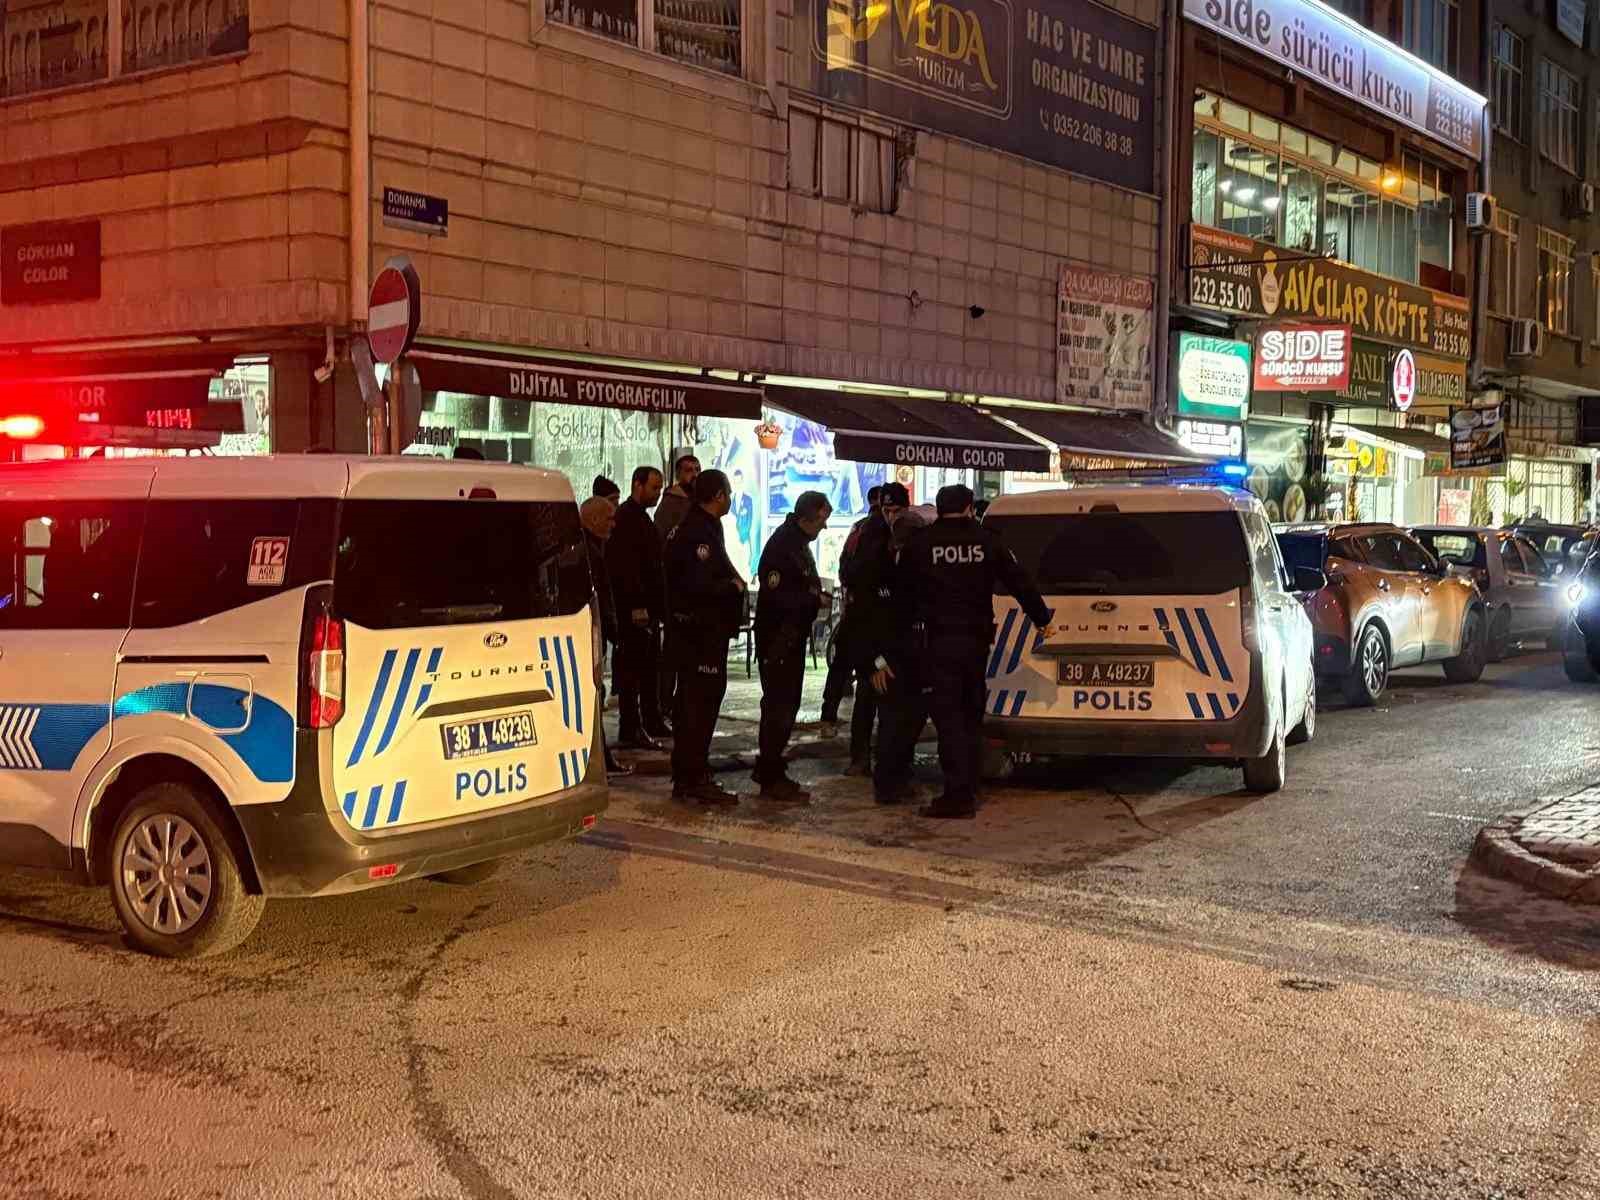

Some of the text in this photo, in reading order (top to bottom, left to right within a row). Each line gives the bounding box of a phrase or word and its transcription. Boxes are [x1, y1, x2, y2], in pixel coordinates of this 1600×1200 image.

[1027, 8, 1145, 86] HAC VE UMRE
[915, 55, 966, 91] TURİZM
[1281, 19, 1353, 90] sürücü
[1363, 48, 1414, 117] kursu
[1032, 58, 1140, 122] ORGANİZASYONU
[1053, 112, 1133, 157] 0352 206 38 38
[388, 191, 427, 209] DONANMA
[17, 242, 75, 262] GÖKHAN
[24, 266, 69, 284] COLOR
[1193, 275, 1252, 311] 232 55 00
[1284, 263, 1429, 344] AVCILAR KÖFTE
[1434, 331, 1448, 352] 232
[1449, 334, 1459, 355] 55
[1305, 362, 1345, 376] KURSU
[1352, 352, 1385, 384] ANLI
[509, 371, 569, 398] DİJİTAL
[413, 427, 455, 447] HAN
[547, 413, 605, 438] Gökha
[896, 442, 1006, 468] GÖKHAN COLOR
[254, 541, 287, 564] 112
[1059, 624, 1169, 632] OURNEO
[430, 662, 549, 682] TOURNEO
[1066, 663, 1150, 681] 38 A 48237
[452, 714, 533, 751] 38 A 48239
